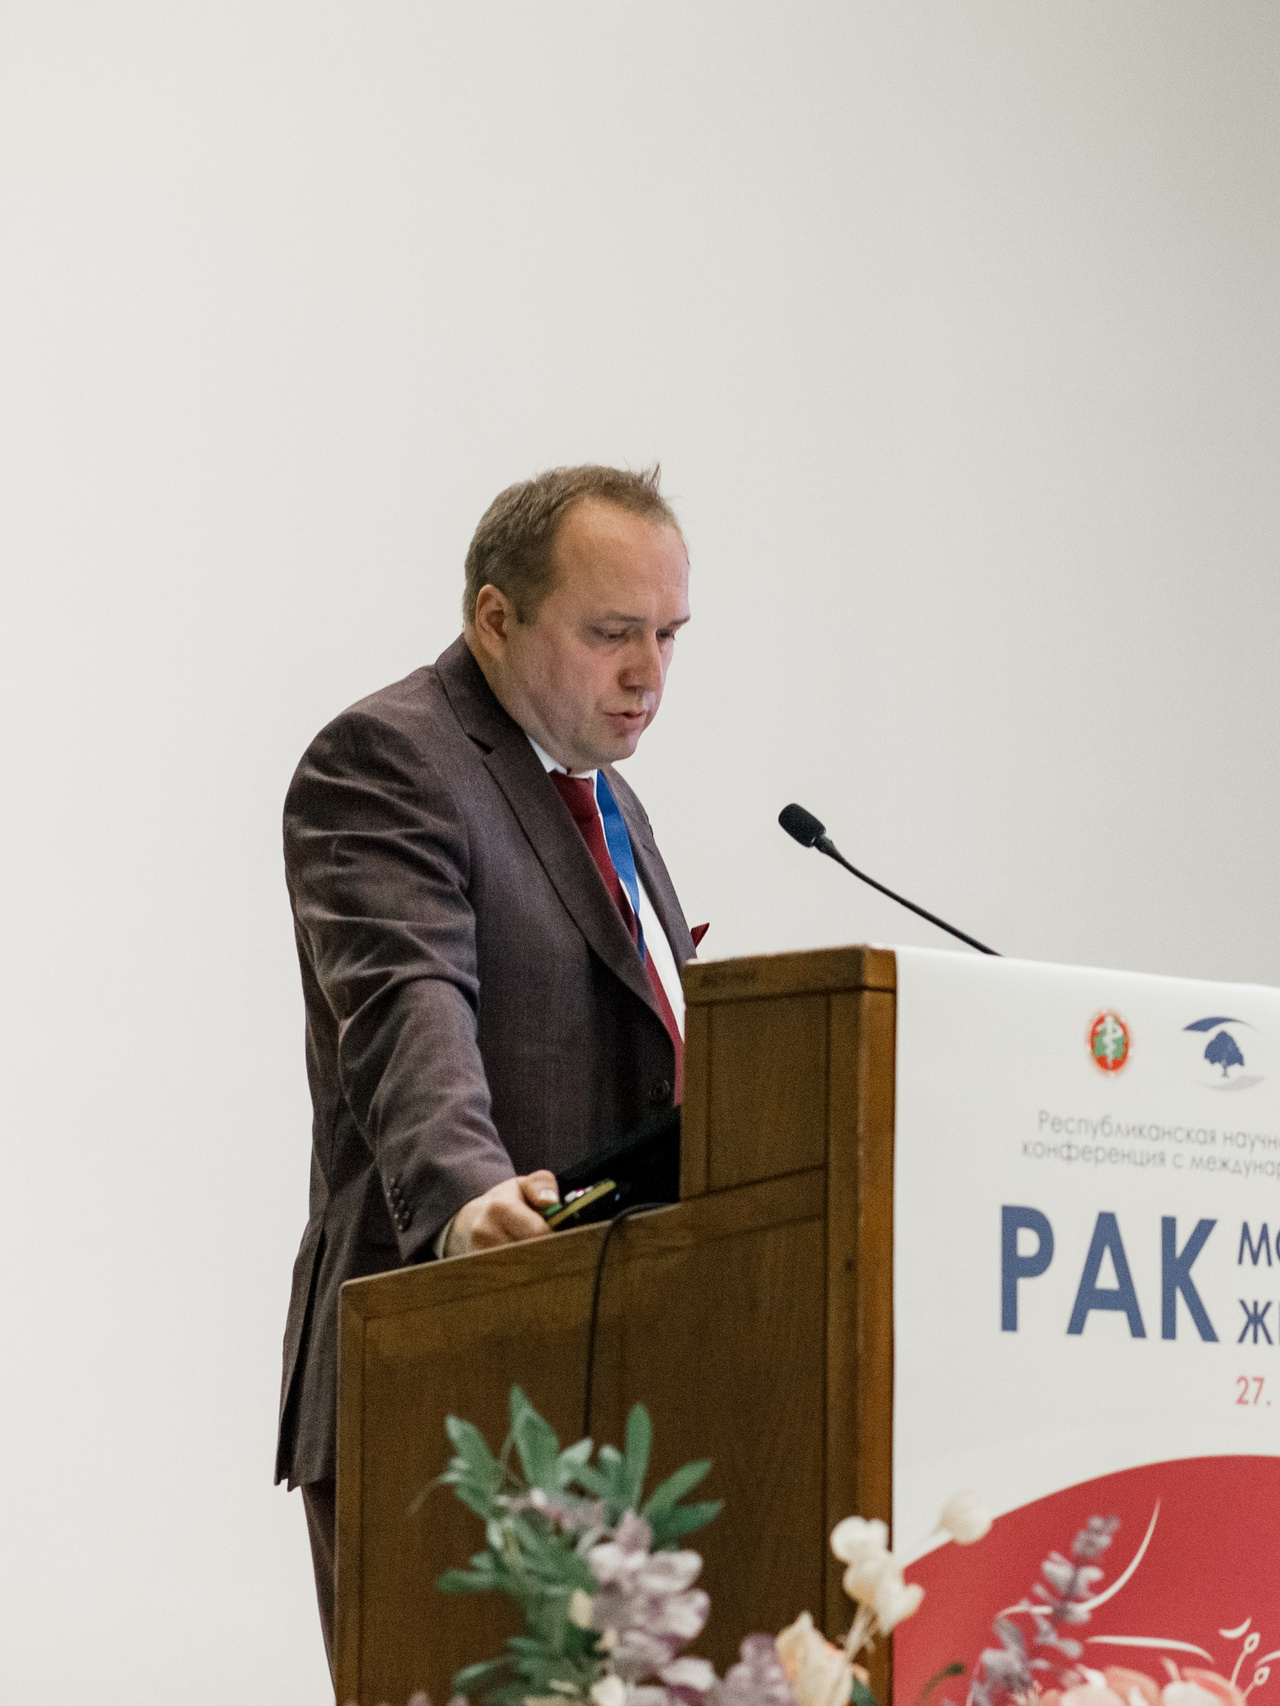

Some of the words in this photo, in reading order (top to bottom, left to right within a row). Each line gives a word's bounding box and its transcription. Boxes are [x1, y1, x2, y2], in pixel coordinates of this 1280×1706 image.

[1037, 1110, 1217, 1146] Республиканская
[1022, 1140, 1167, 1167] конференция
[1172, 1152, 1184, 1170] с
[1000, 1204, 1220, 1344] РАК
